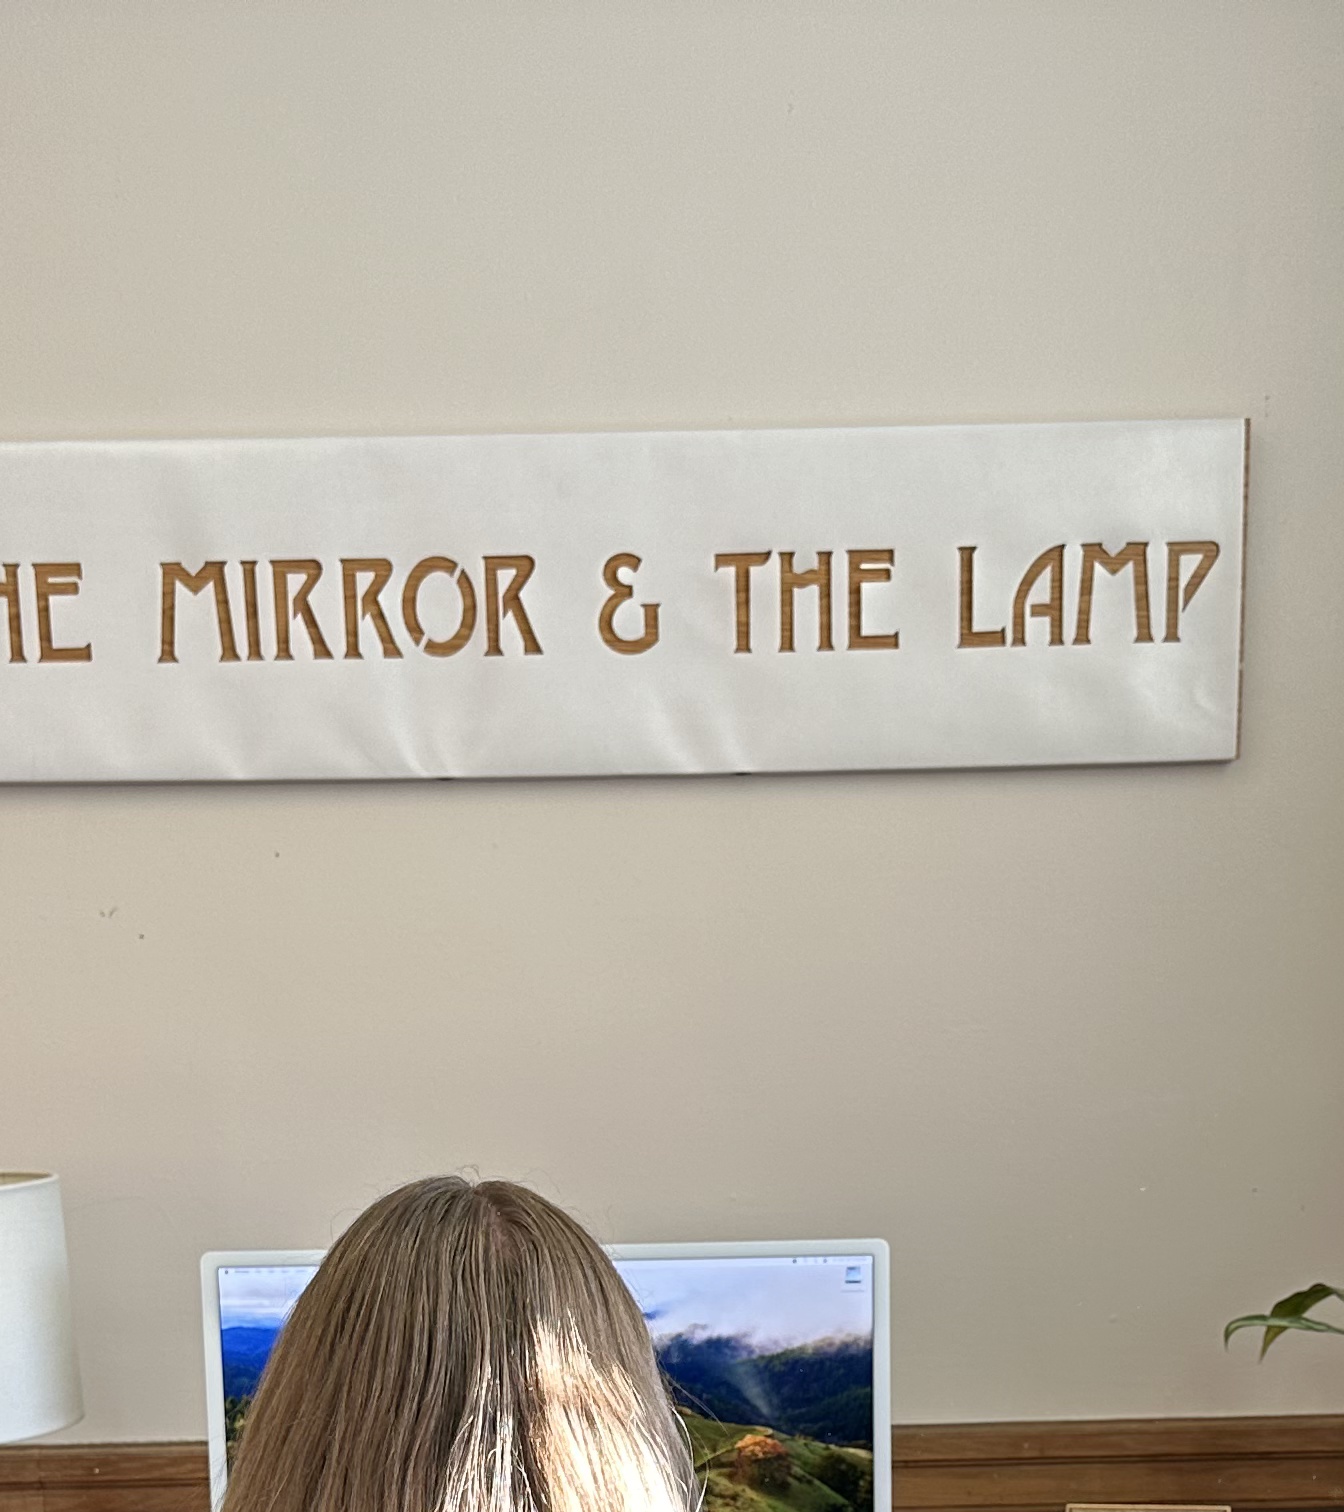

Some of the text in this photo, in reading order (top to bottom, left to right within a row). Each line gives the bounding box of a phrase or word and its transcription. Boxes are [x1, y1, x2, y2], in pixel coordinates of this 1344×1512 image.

[158, 553, 544, 664] MIRROR
[597, 551, 660, 655] &
[713, 547, 900, 654] THE
[958, 540, 1220, 649] LAMP
